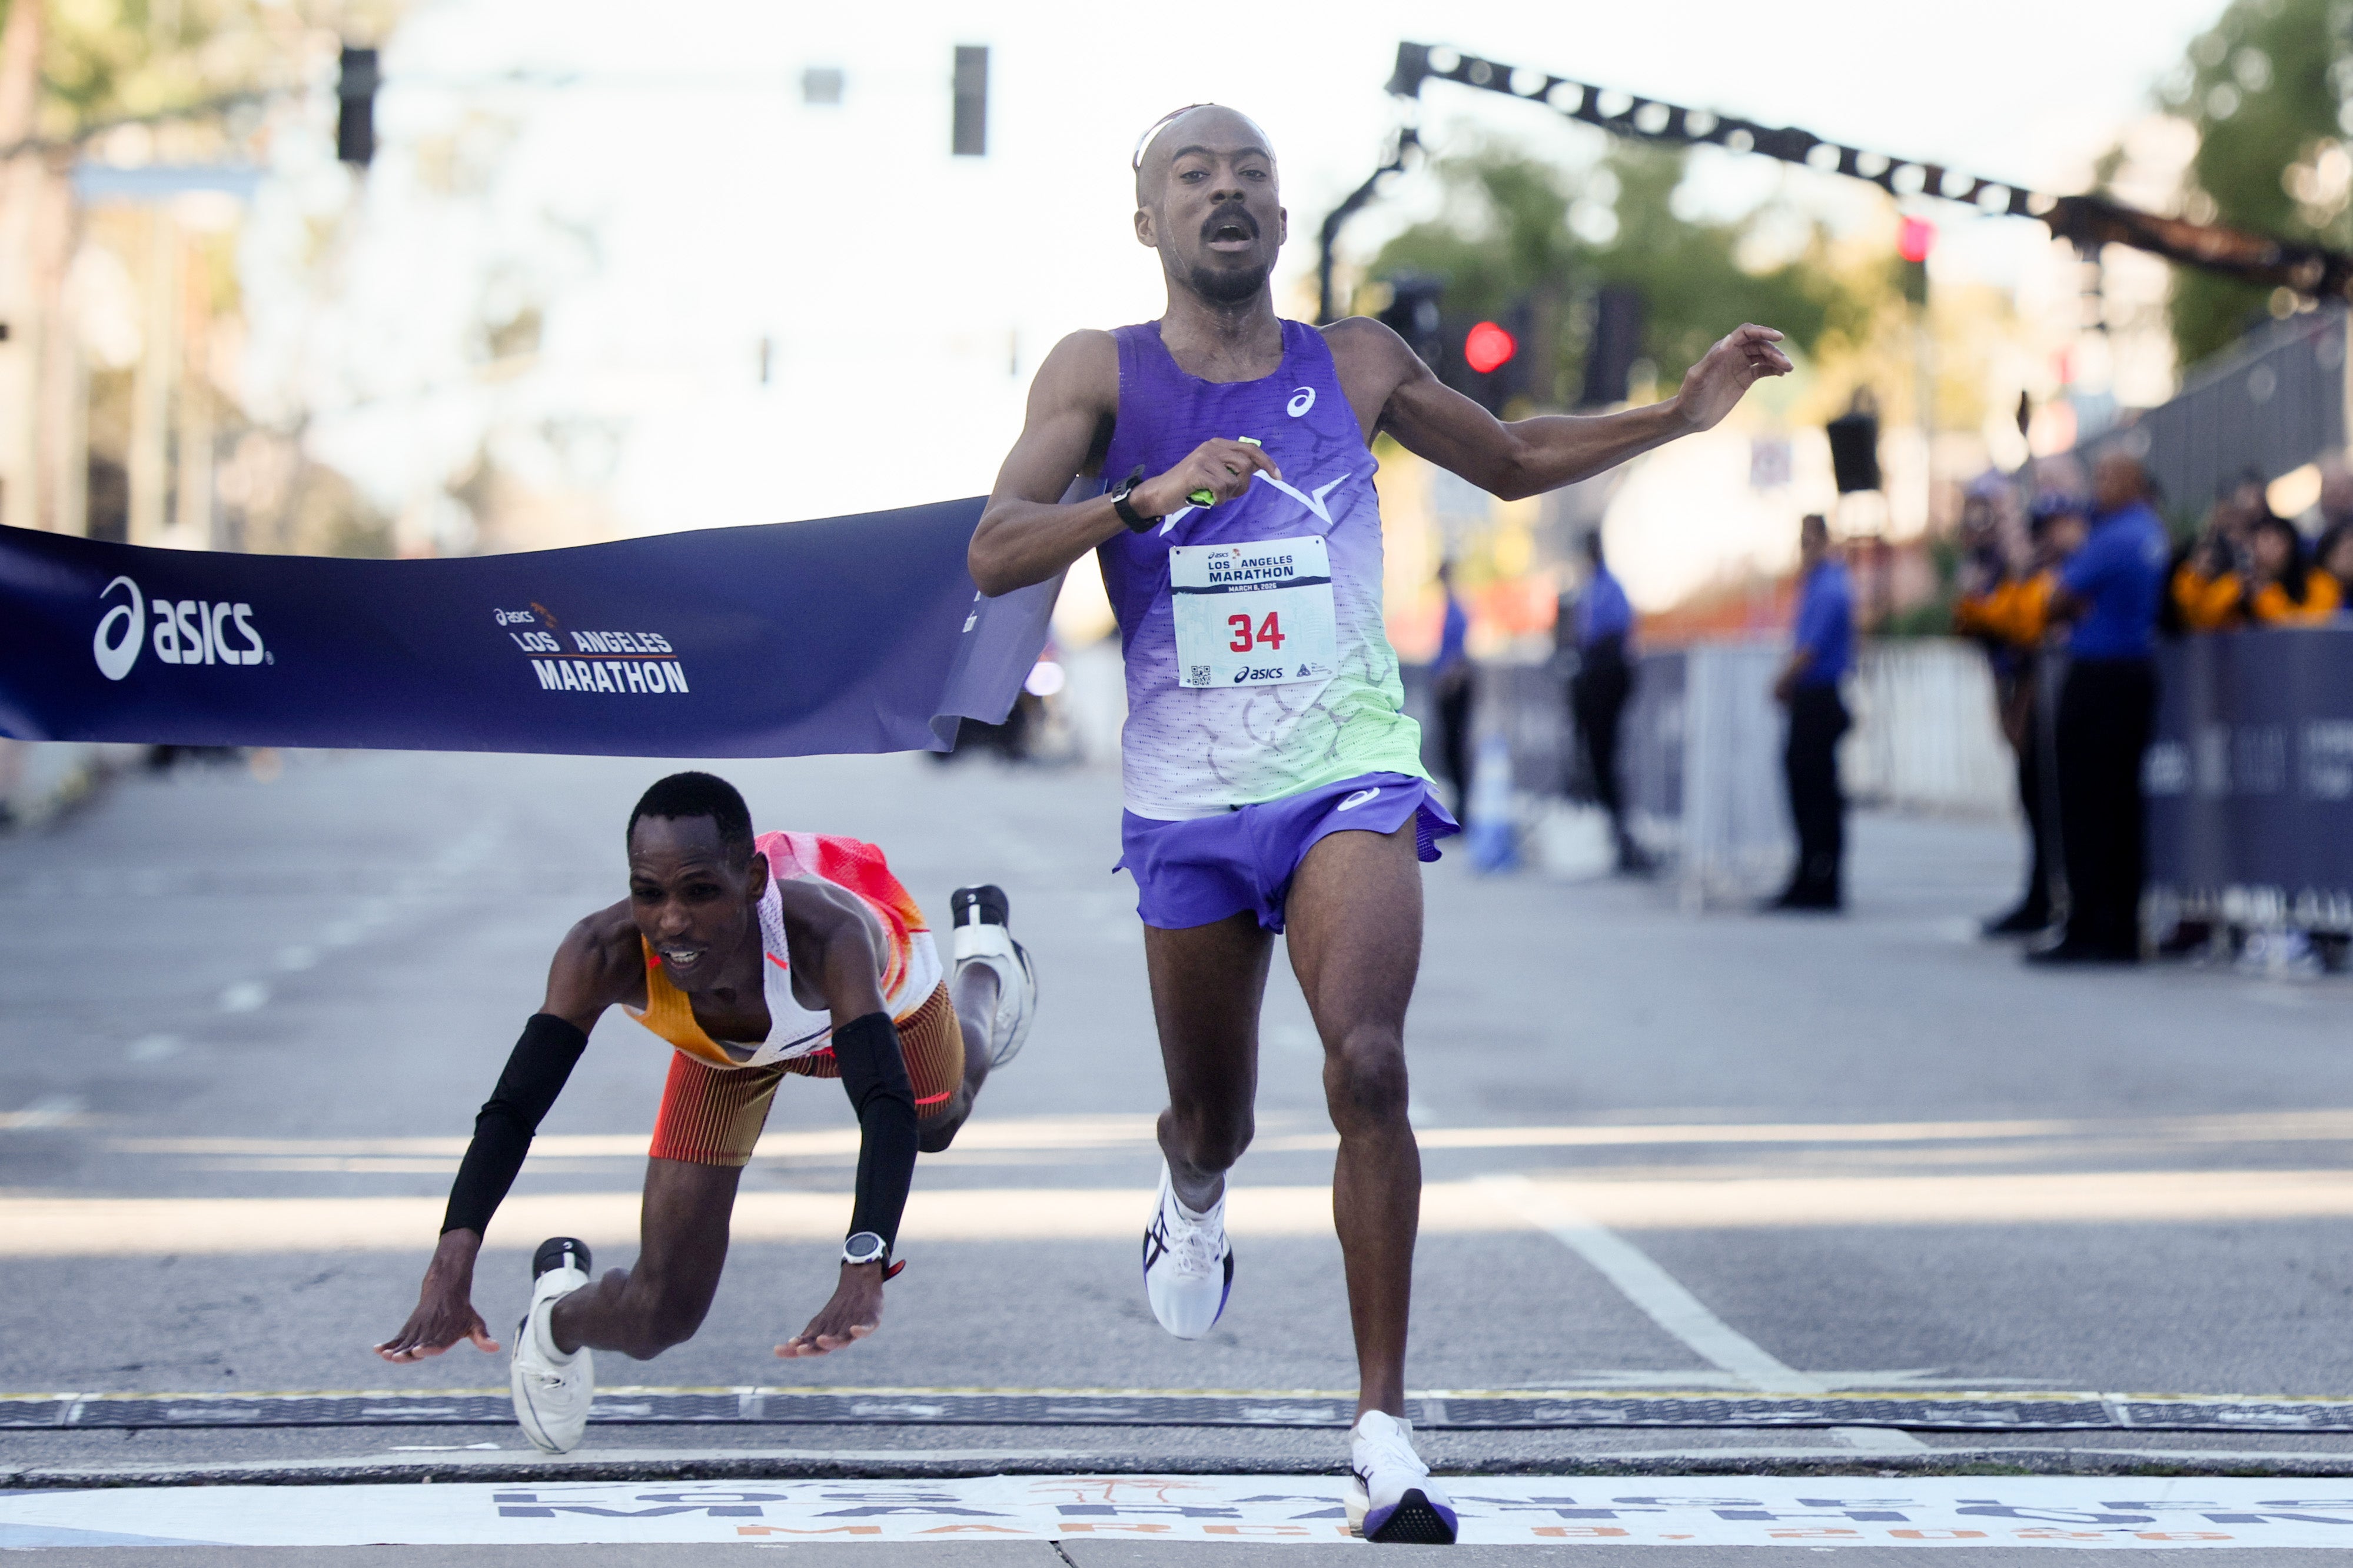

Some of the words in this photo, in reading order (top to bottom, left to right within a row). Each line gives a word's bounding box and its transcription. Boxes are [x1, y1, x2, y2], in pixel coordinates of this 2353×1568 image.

[1208, 561, 1230, 570] LOS
[1241, 555, 1293, 568] ANGELES
[1209, 565, 1294, 582] MARATHON
[1228, 584, 1254, 592] MARCH
[1228, 611, 1285, 653] 34
[509, 631, 560, 652] LOS
[570, 631, 673, 652] ANGELES
[531, 660, 690, 693] MARATHON
[492, 1493, 963, 1503] LOS
[736, 1523, 1351, 1536] MARC
